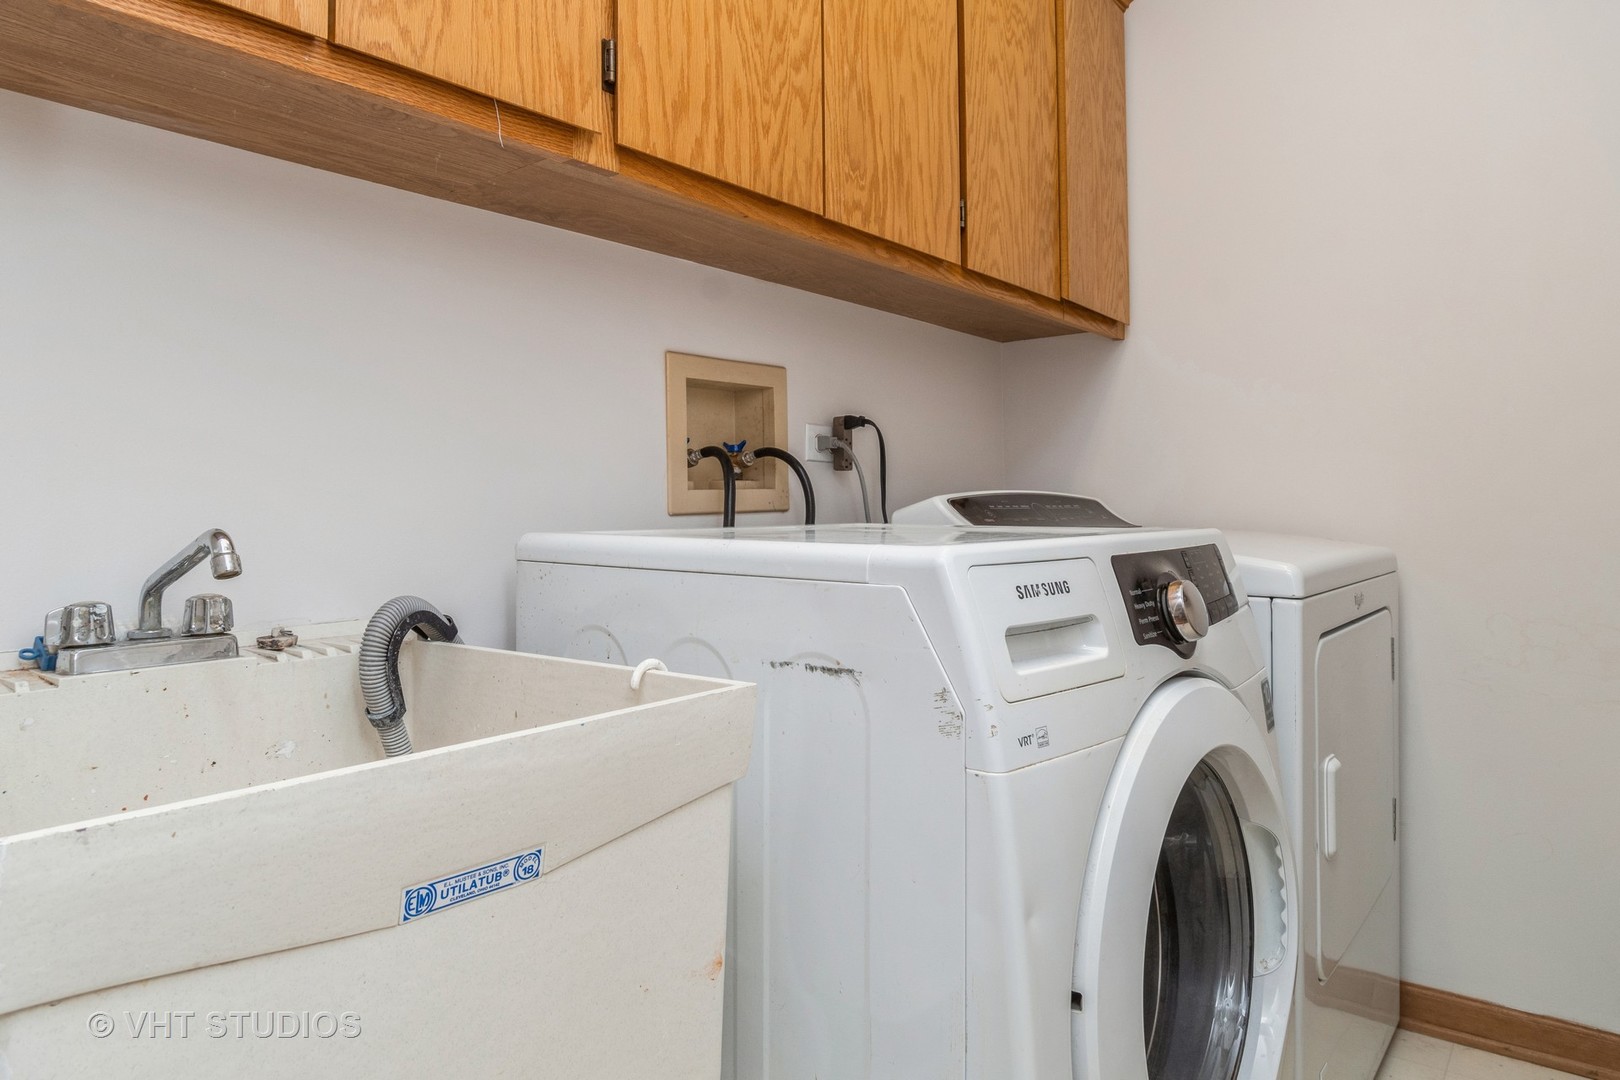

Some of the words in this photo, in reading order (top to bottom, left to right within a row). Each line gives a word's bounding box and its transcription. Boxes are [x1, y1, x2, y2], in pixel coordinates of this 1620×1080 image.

[1015, 580, 1071, 600] SAMSUNG
[519, 856, 538, 868] MODEL
[521, 864, 534, 876] 18
[454, 873, 477, 884] MUSTEE
[477, 885, 489, 893] OHIO
